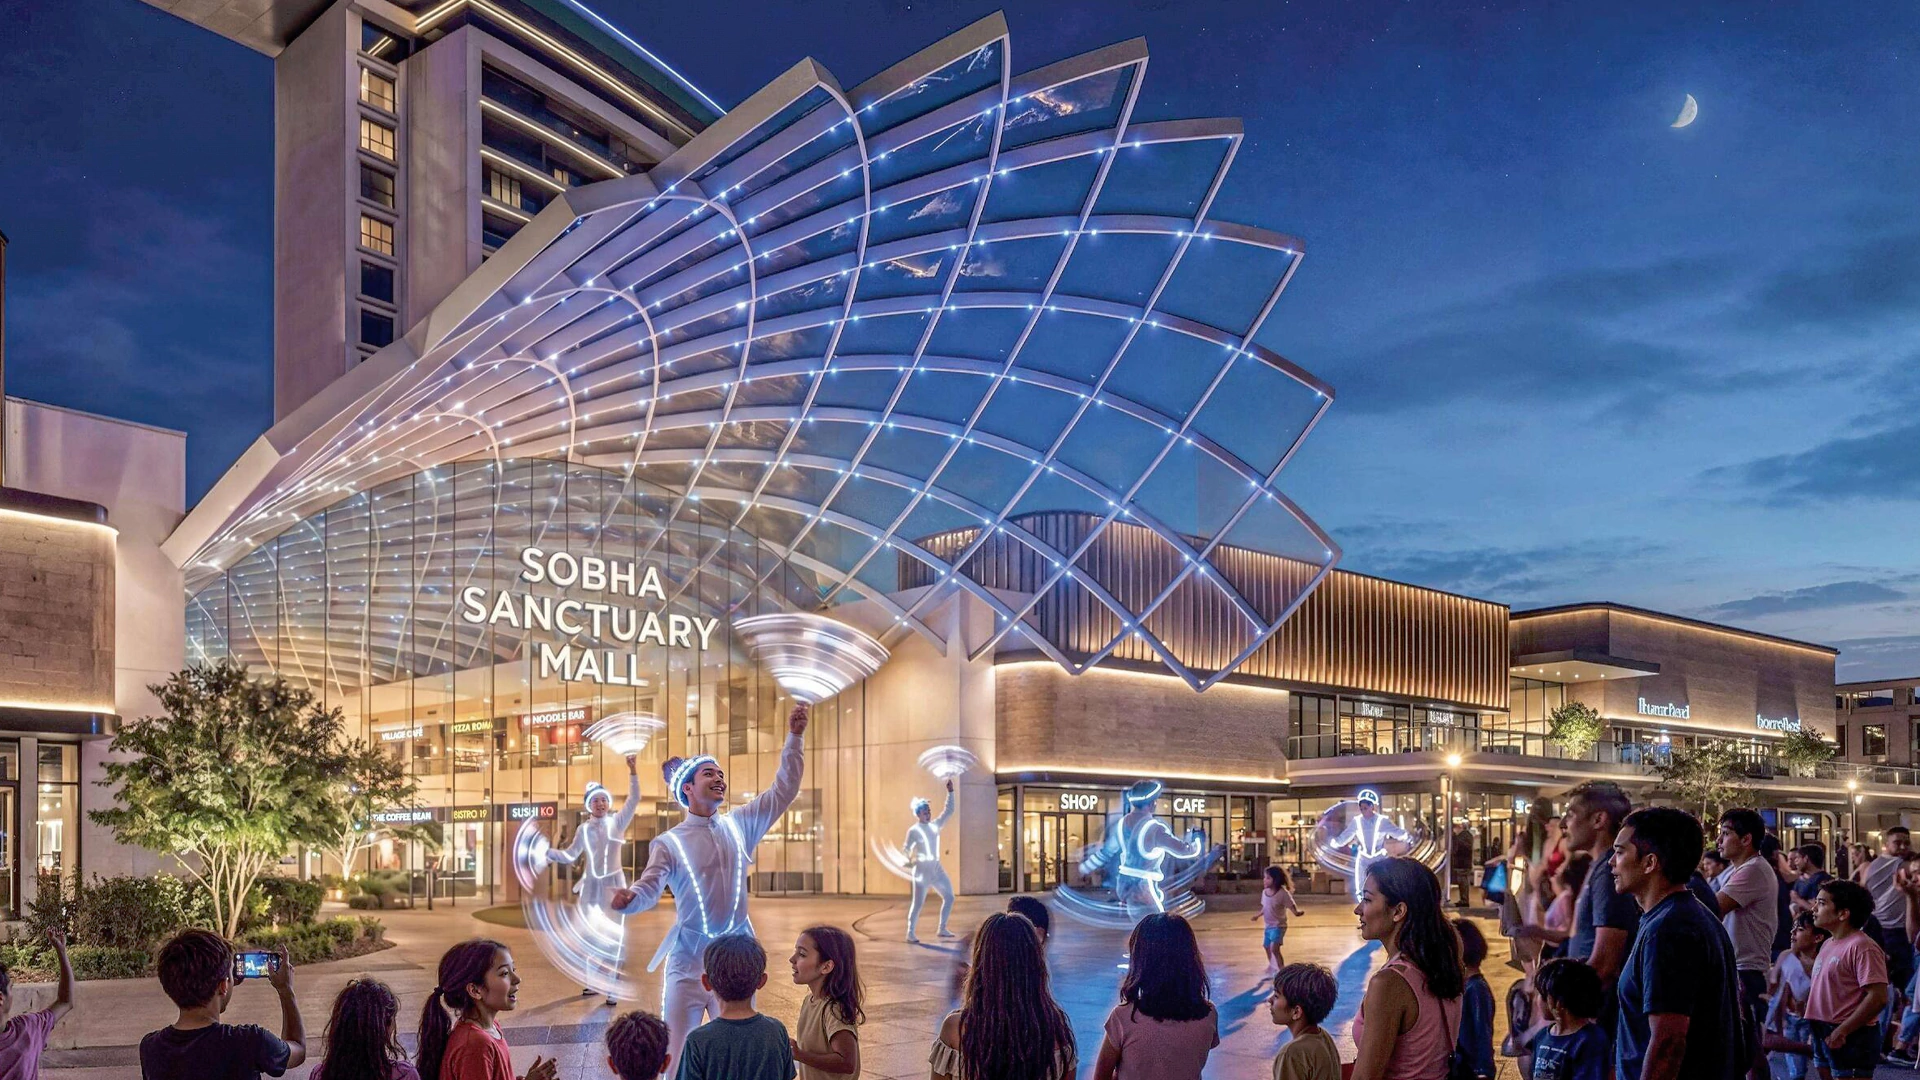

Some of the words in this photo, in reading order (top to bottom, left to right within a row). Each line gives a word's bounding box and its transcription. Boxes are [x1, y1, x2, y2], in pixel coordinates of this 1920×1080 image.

[520, 547, 666, 600] SOBHA
[462, 586, 720, 651] SANCTUARY
[540, 643, 649, 687] MALL
[532, 713, 567, 724] NOODLE
[568, 710, 585, 720] BAR
[381, 729, 406, 741] VILLAGE
[1060, 793, 1099, 811] SHOP
[1173, 797, 1206, 813] CAFE
[373, 813, 386, 822] THE
[386, 812, 412, 822] COFFEE
[412, 811, 432, 821] BEAN
[453, 810, 477, 820] BISTRO
[479, 809, 488, 819] 19
[512, 806, 539, 818] SUSHI
[540, 806, 554, 817] KO
